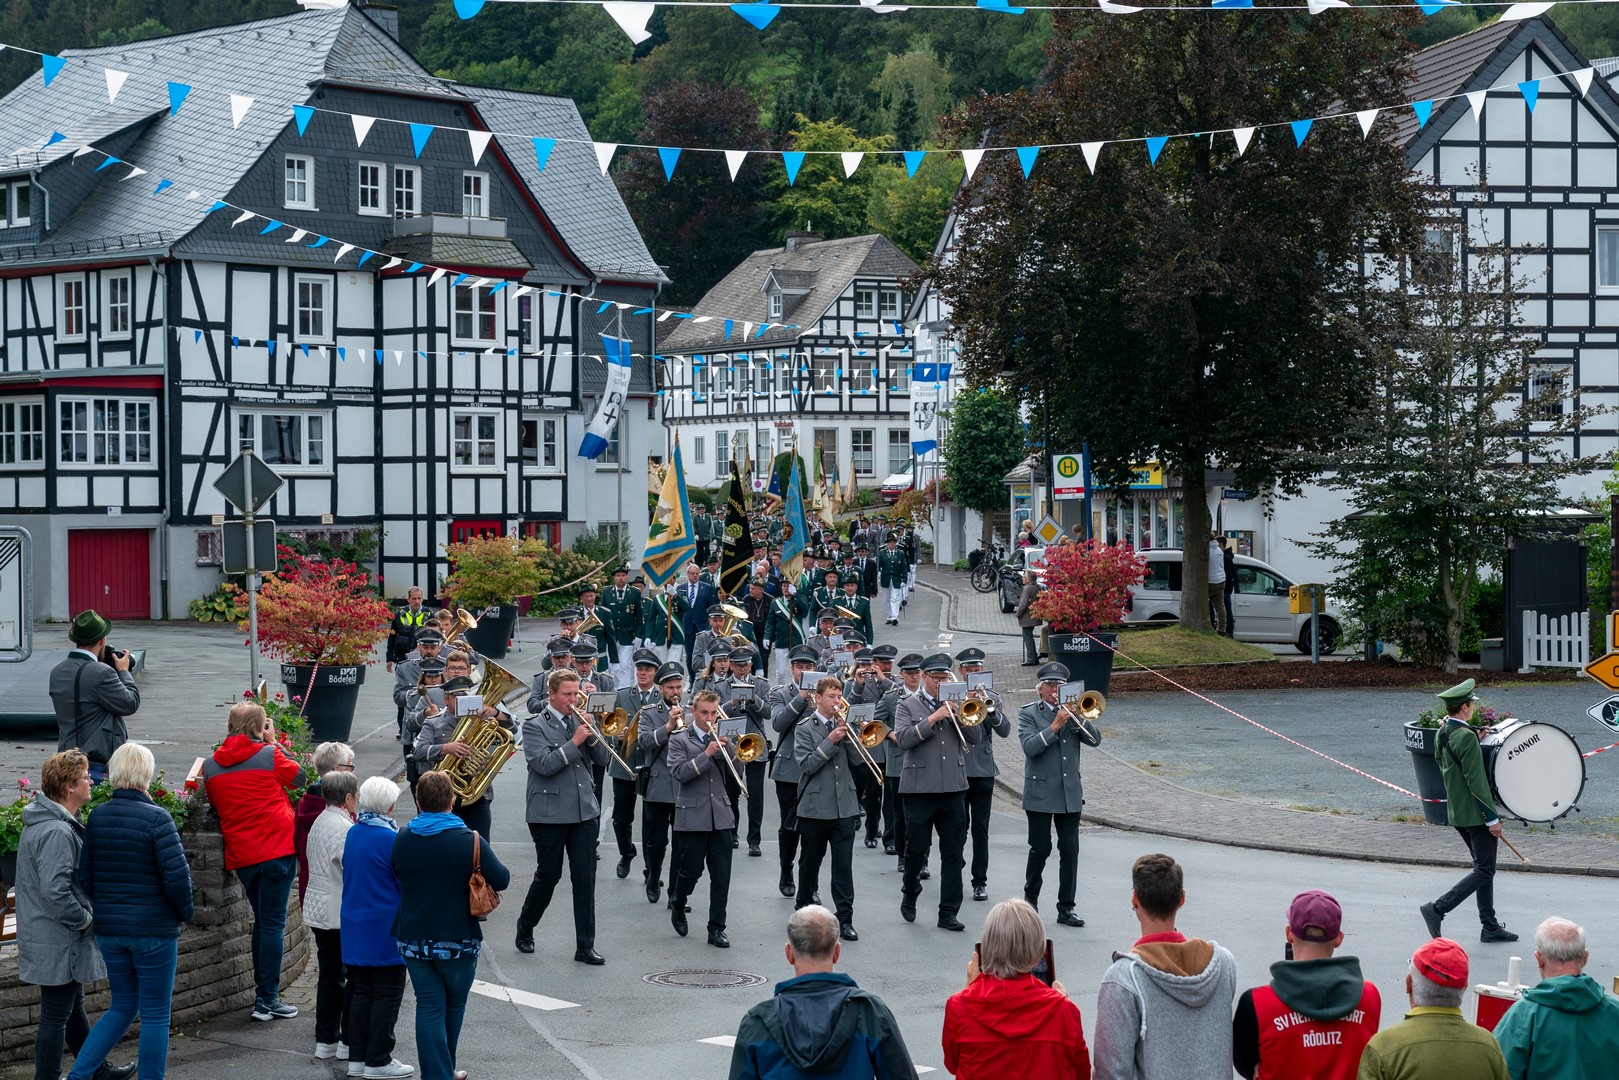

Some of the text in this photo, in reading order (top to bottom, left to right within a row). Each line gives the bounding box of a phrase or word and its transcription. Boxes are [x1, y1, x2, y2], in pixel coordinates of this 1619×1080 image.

[1063, 460, 1073, 473] H
[1064, 643, 1090, 651] Bödefeld
[329, 675, 357, 683] Bödefeld
[1513, 733, 1541, 756] SONOR
[1274, 1014, 1289, 1031] SV
[1303, 1030, 1342, 1047] RÖDLITZ
